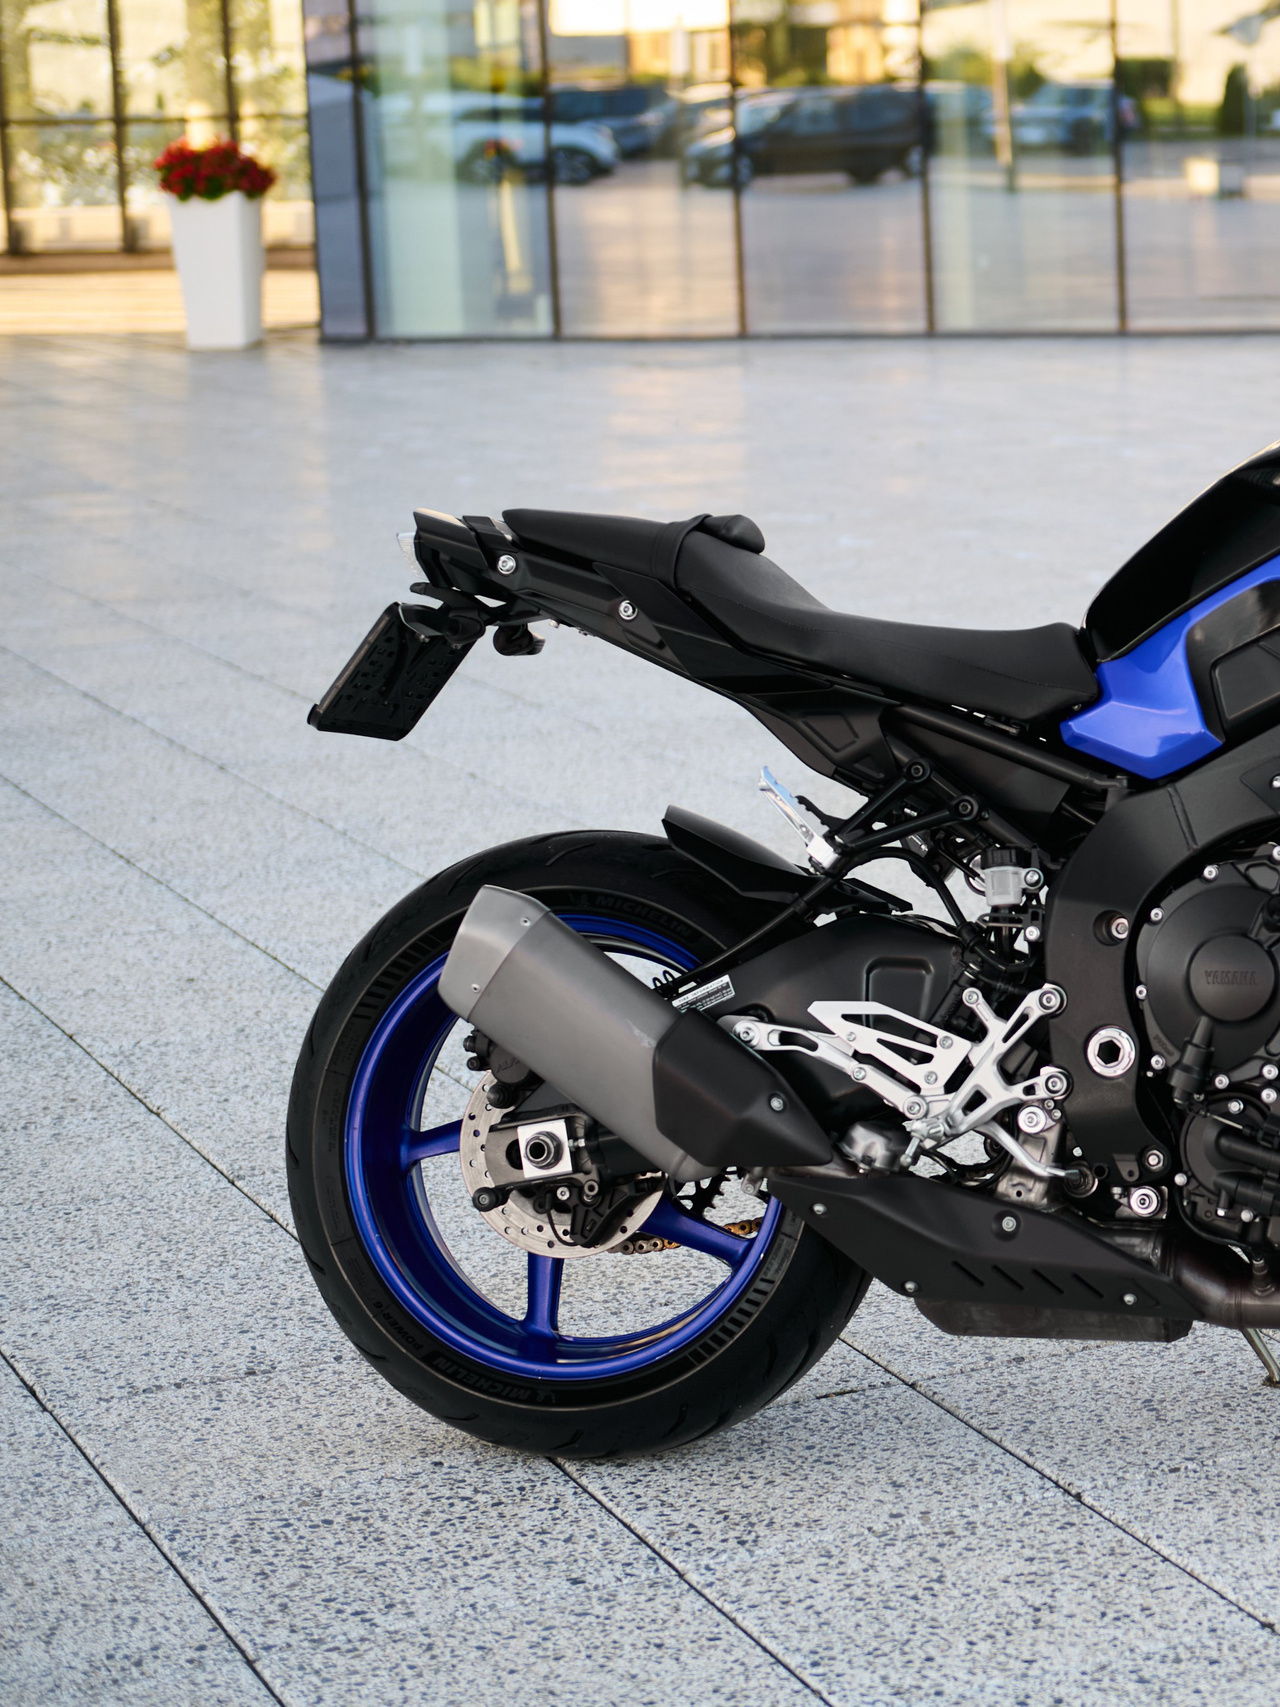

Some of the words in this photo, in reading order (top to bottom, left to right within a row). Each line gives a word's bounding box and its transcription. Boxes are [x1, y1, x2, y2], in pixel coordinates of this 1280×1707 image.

[595, 895, 692, 936] MICHELIN
[1204, 970, 1258, 986] YAMAHA
[382, 1311, 424, 1351] POWER
[432, 1356, 530, 1401] MICHELIN
